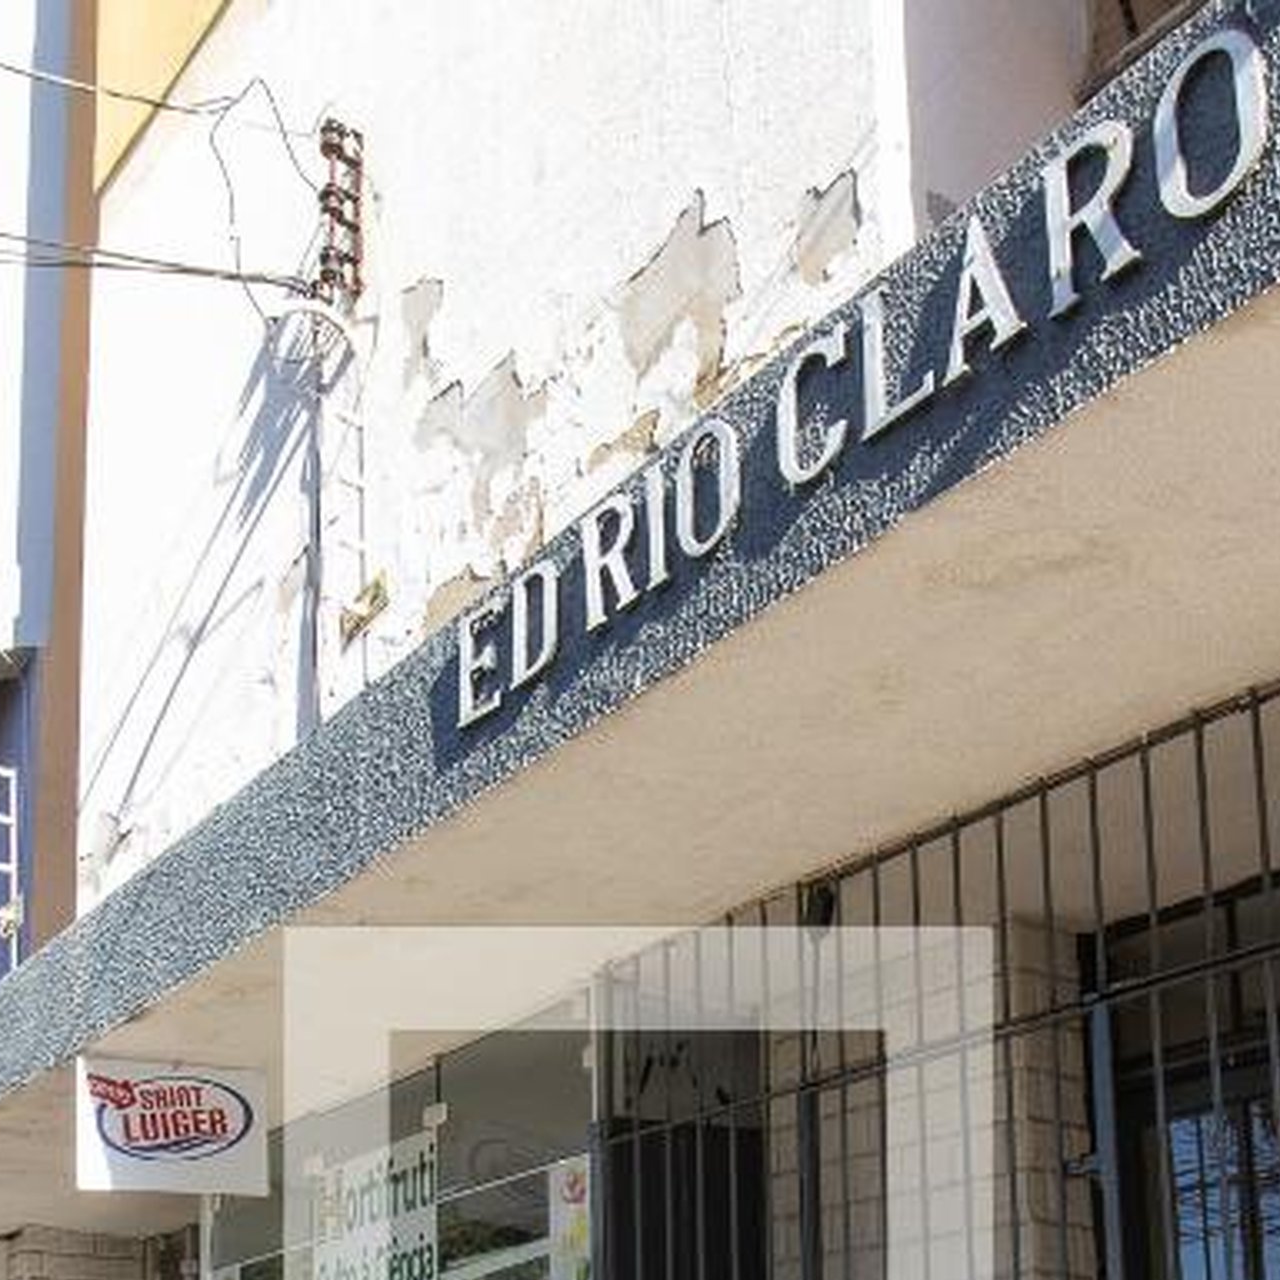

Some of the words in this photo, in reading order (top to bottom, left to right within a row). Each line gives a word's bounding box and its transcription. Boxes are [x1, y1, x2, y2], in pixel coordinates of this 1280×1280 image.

[456, 560, 562, 730] ED
[582, 418, 743, 632] RIO
[777, 28, 1272, 486] CLARO
